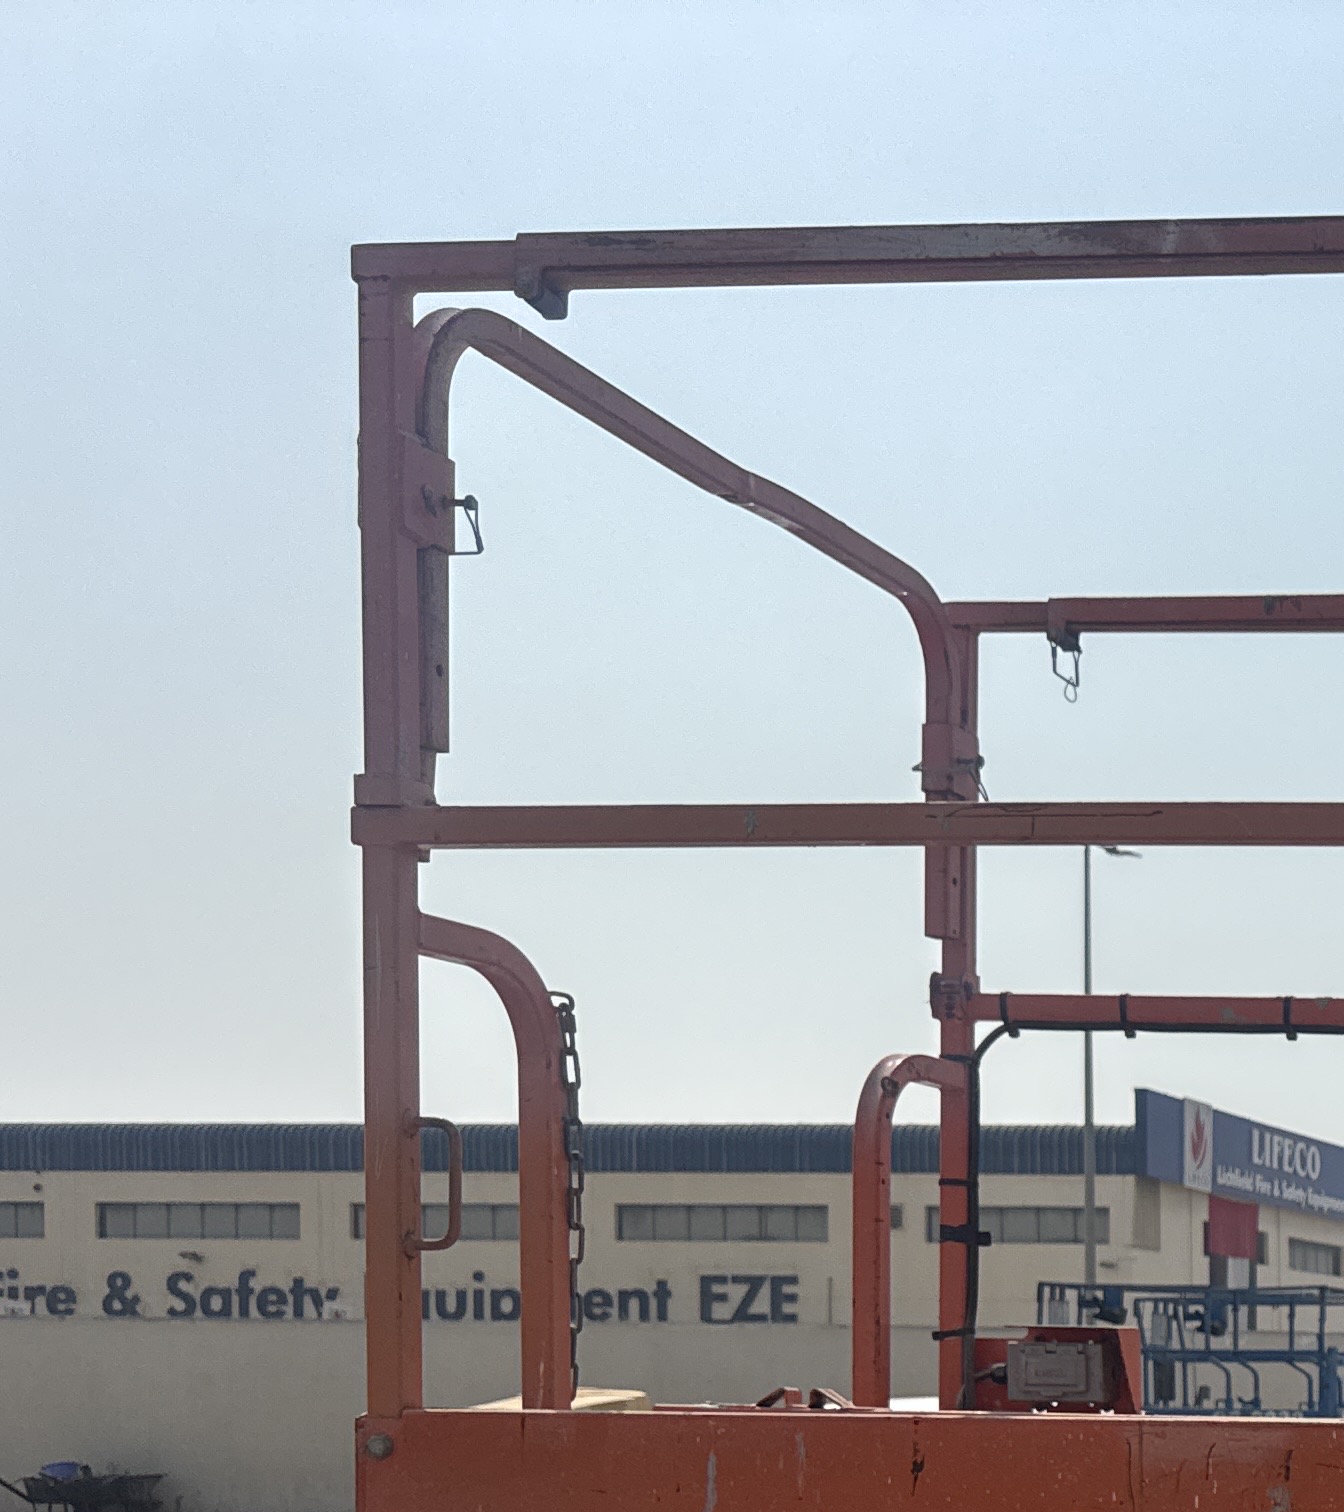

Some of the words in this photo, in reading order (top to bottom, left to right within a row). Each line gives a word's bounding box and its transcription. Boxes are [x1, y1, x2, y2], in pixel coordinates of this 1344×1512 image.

[1251, 1128, 1322, 1181] LIFECO
[0, 1268, 77, 1317] ire
[102, 1270, 141, 1317] &
